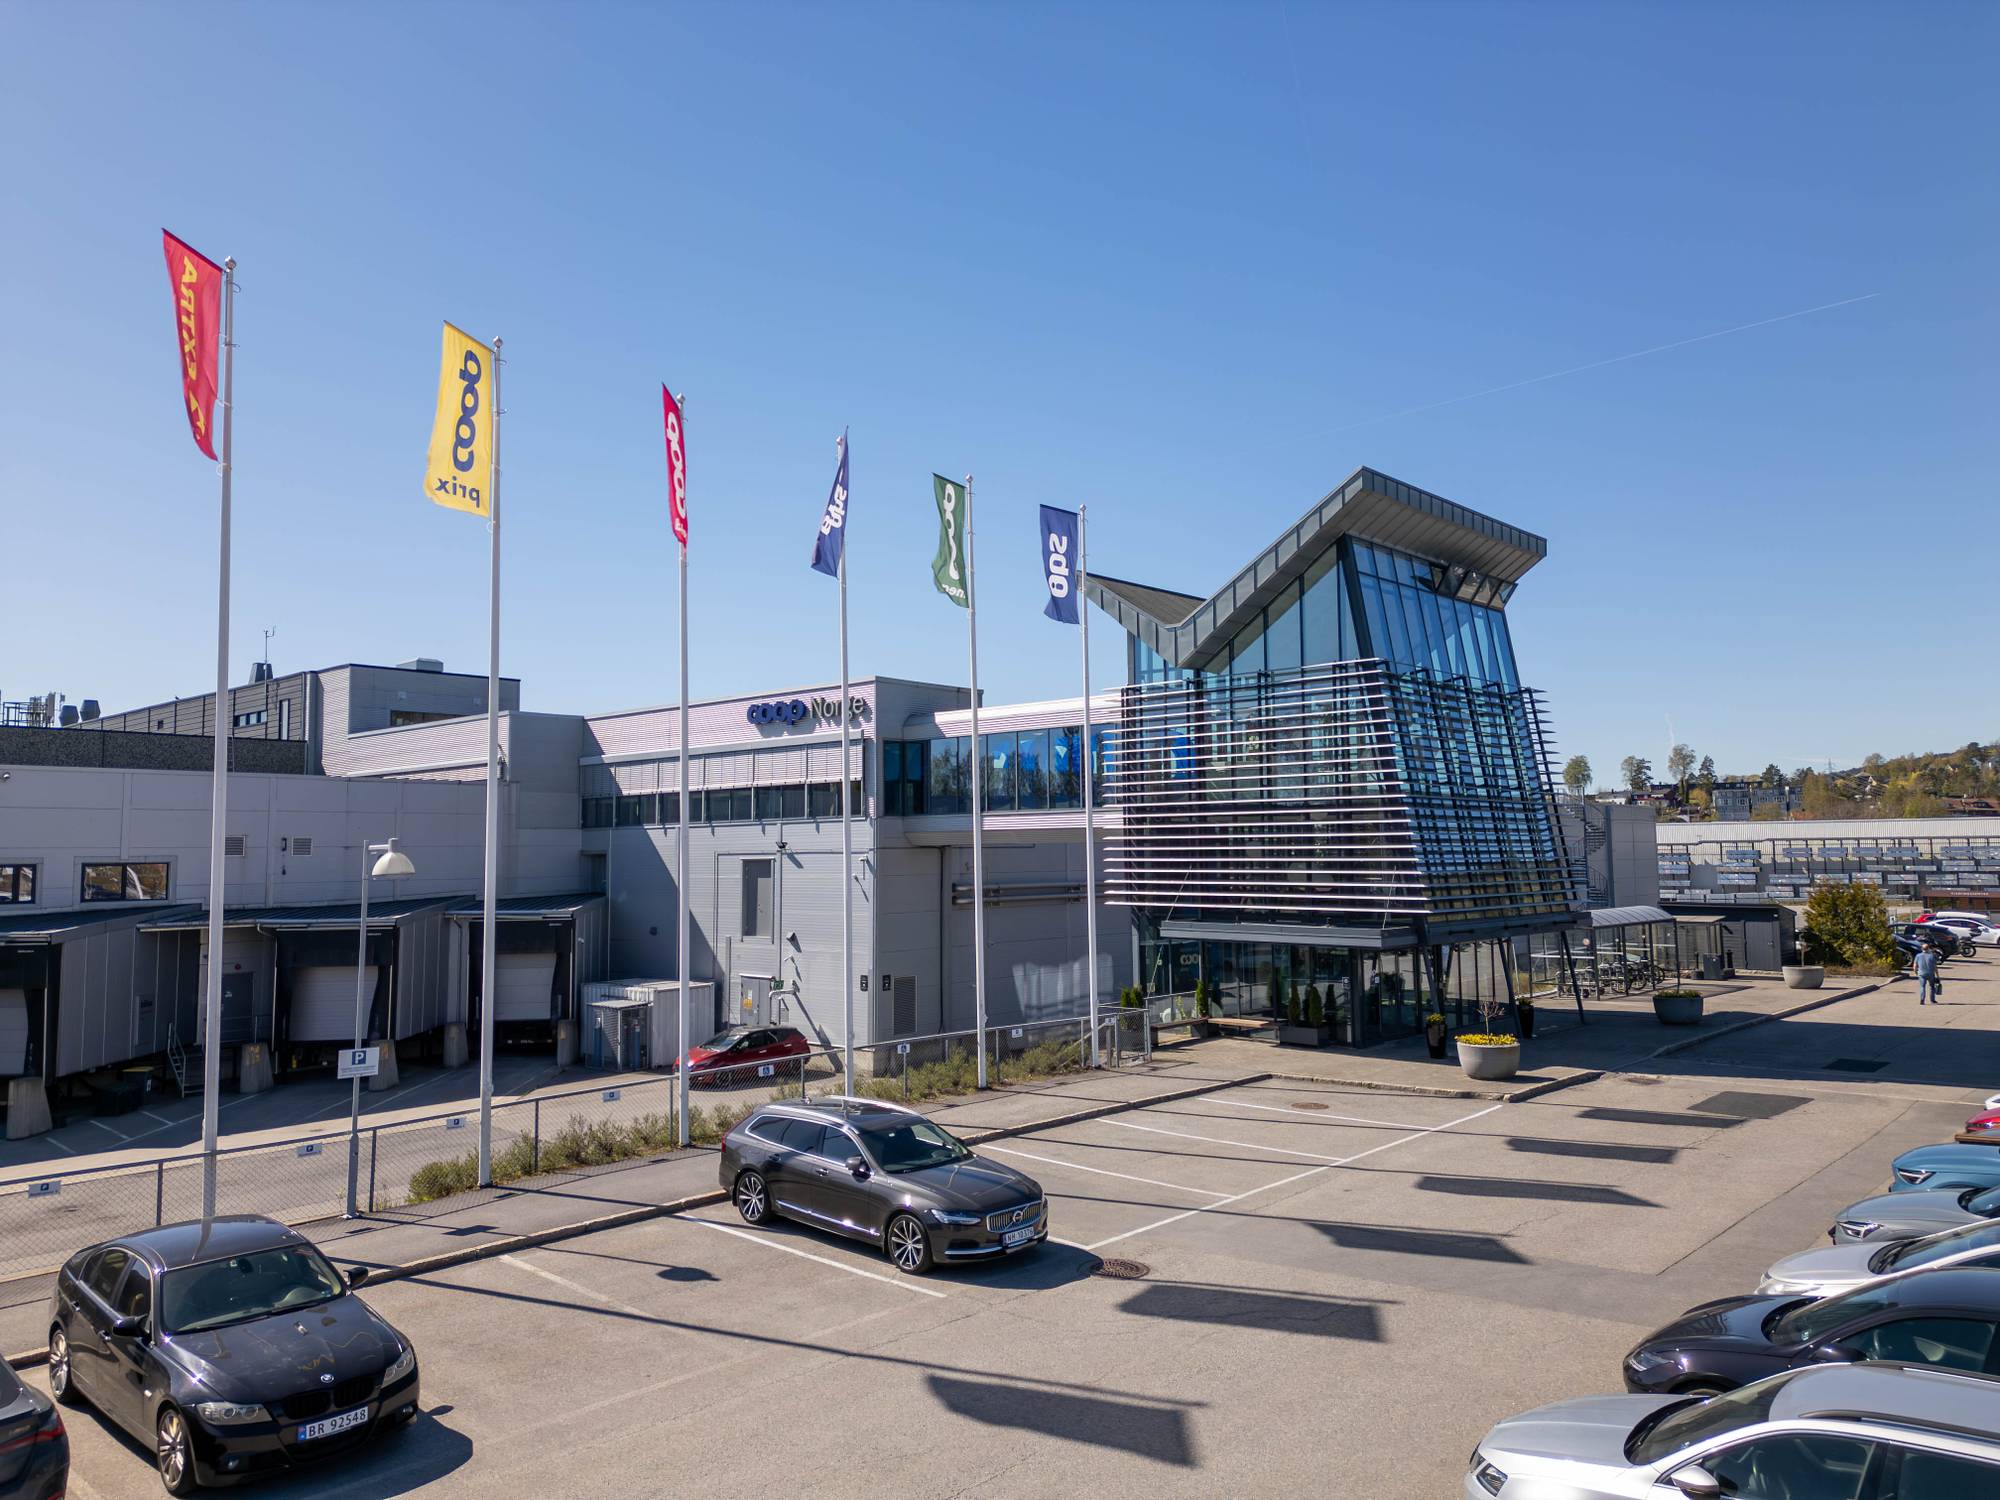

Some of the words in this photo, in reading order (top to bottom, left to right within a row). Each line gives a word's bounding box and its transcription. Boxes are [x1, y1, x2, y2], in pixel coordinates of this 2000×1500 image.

[747, 699, 806, 725] coop
[1180, 953, 1200, 965] coo
[355, 1051, 365, 1064] P
[308, 1423, 325, 1438] BR
[330, 1409, 367, 1430] 92548
